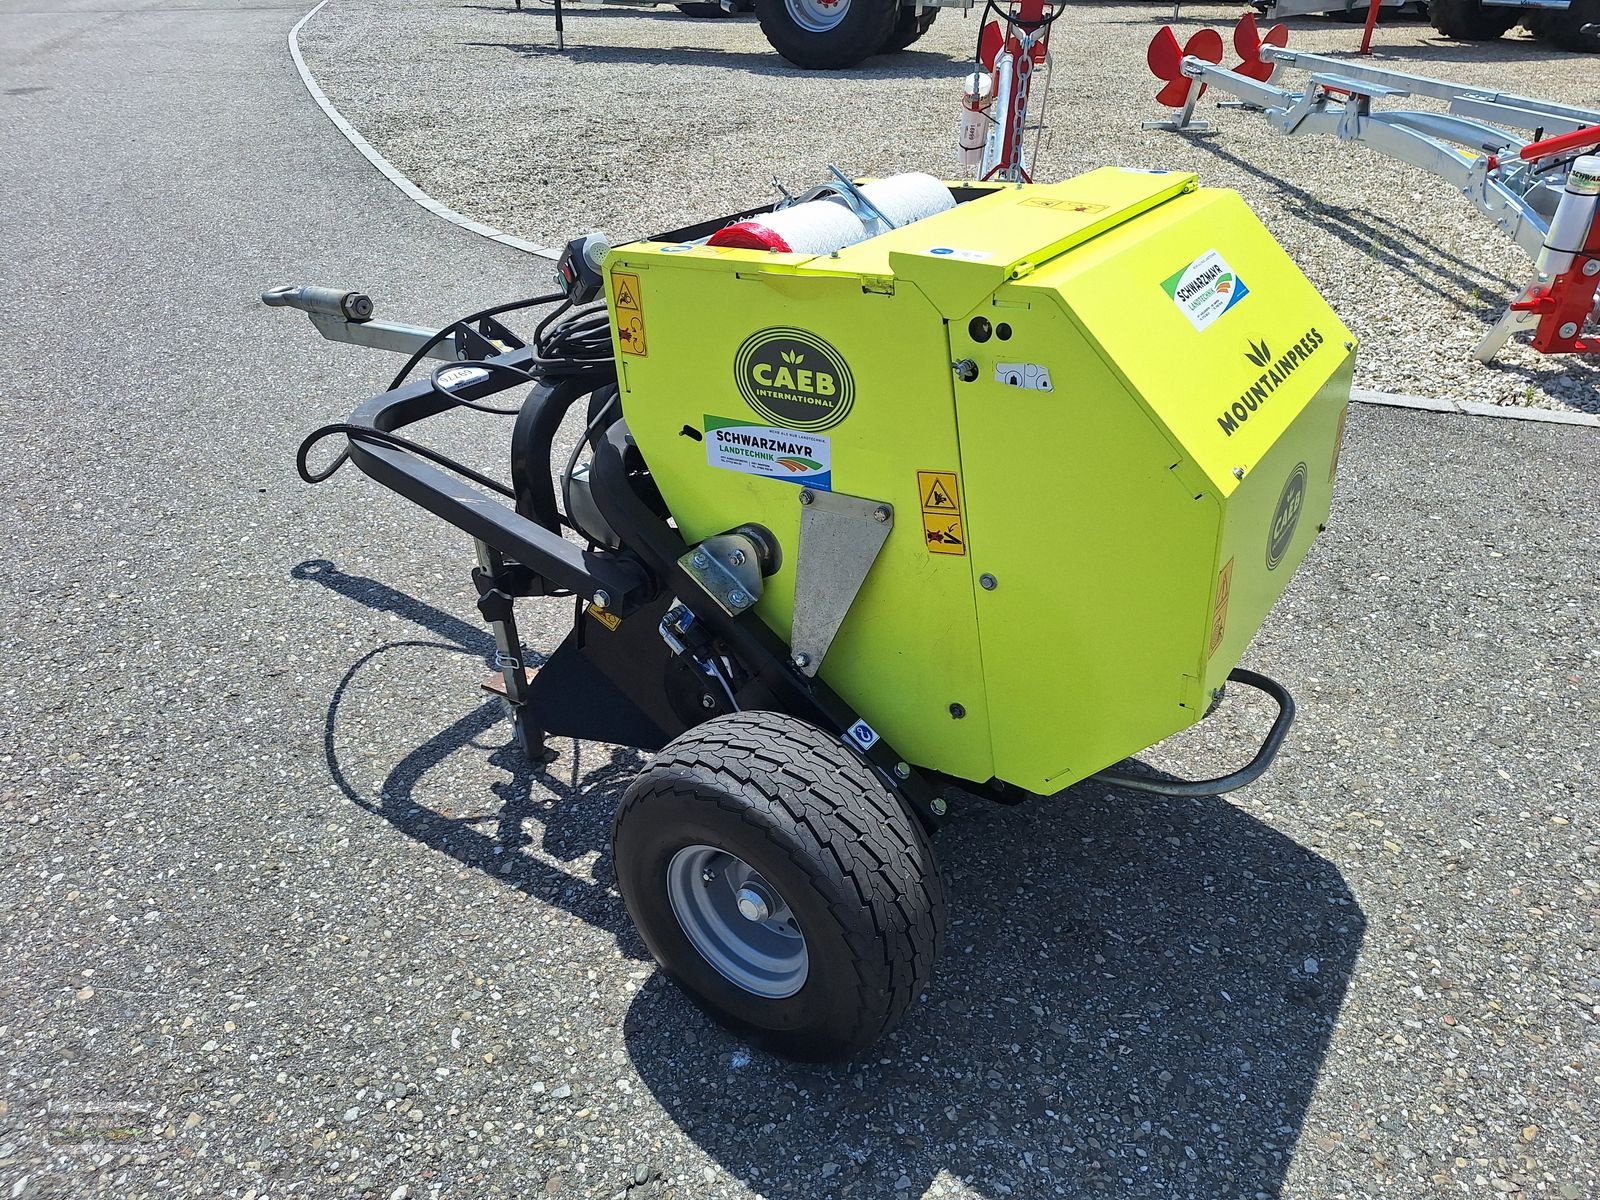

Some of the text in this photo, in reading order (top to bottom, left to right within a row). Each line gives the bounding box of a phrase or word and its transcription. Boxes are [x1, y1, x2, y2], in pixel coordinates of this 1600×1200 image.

[1176, 264, 1223, 302] SCHWARZMAYR
[752, 363, 836, 396] CAEB
[1217, 327, 1324, 437] MOUNTAINPRESS
[756, 388, 834, 408] INTERNATIONAL
[716, 430, 813, 458] SCHWARZMAYR
[719, 444, 775, 461] LANDTECHNIK
[1273, 490, 1301, 540] CAEB
